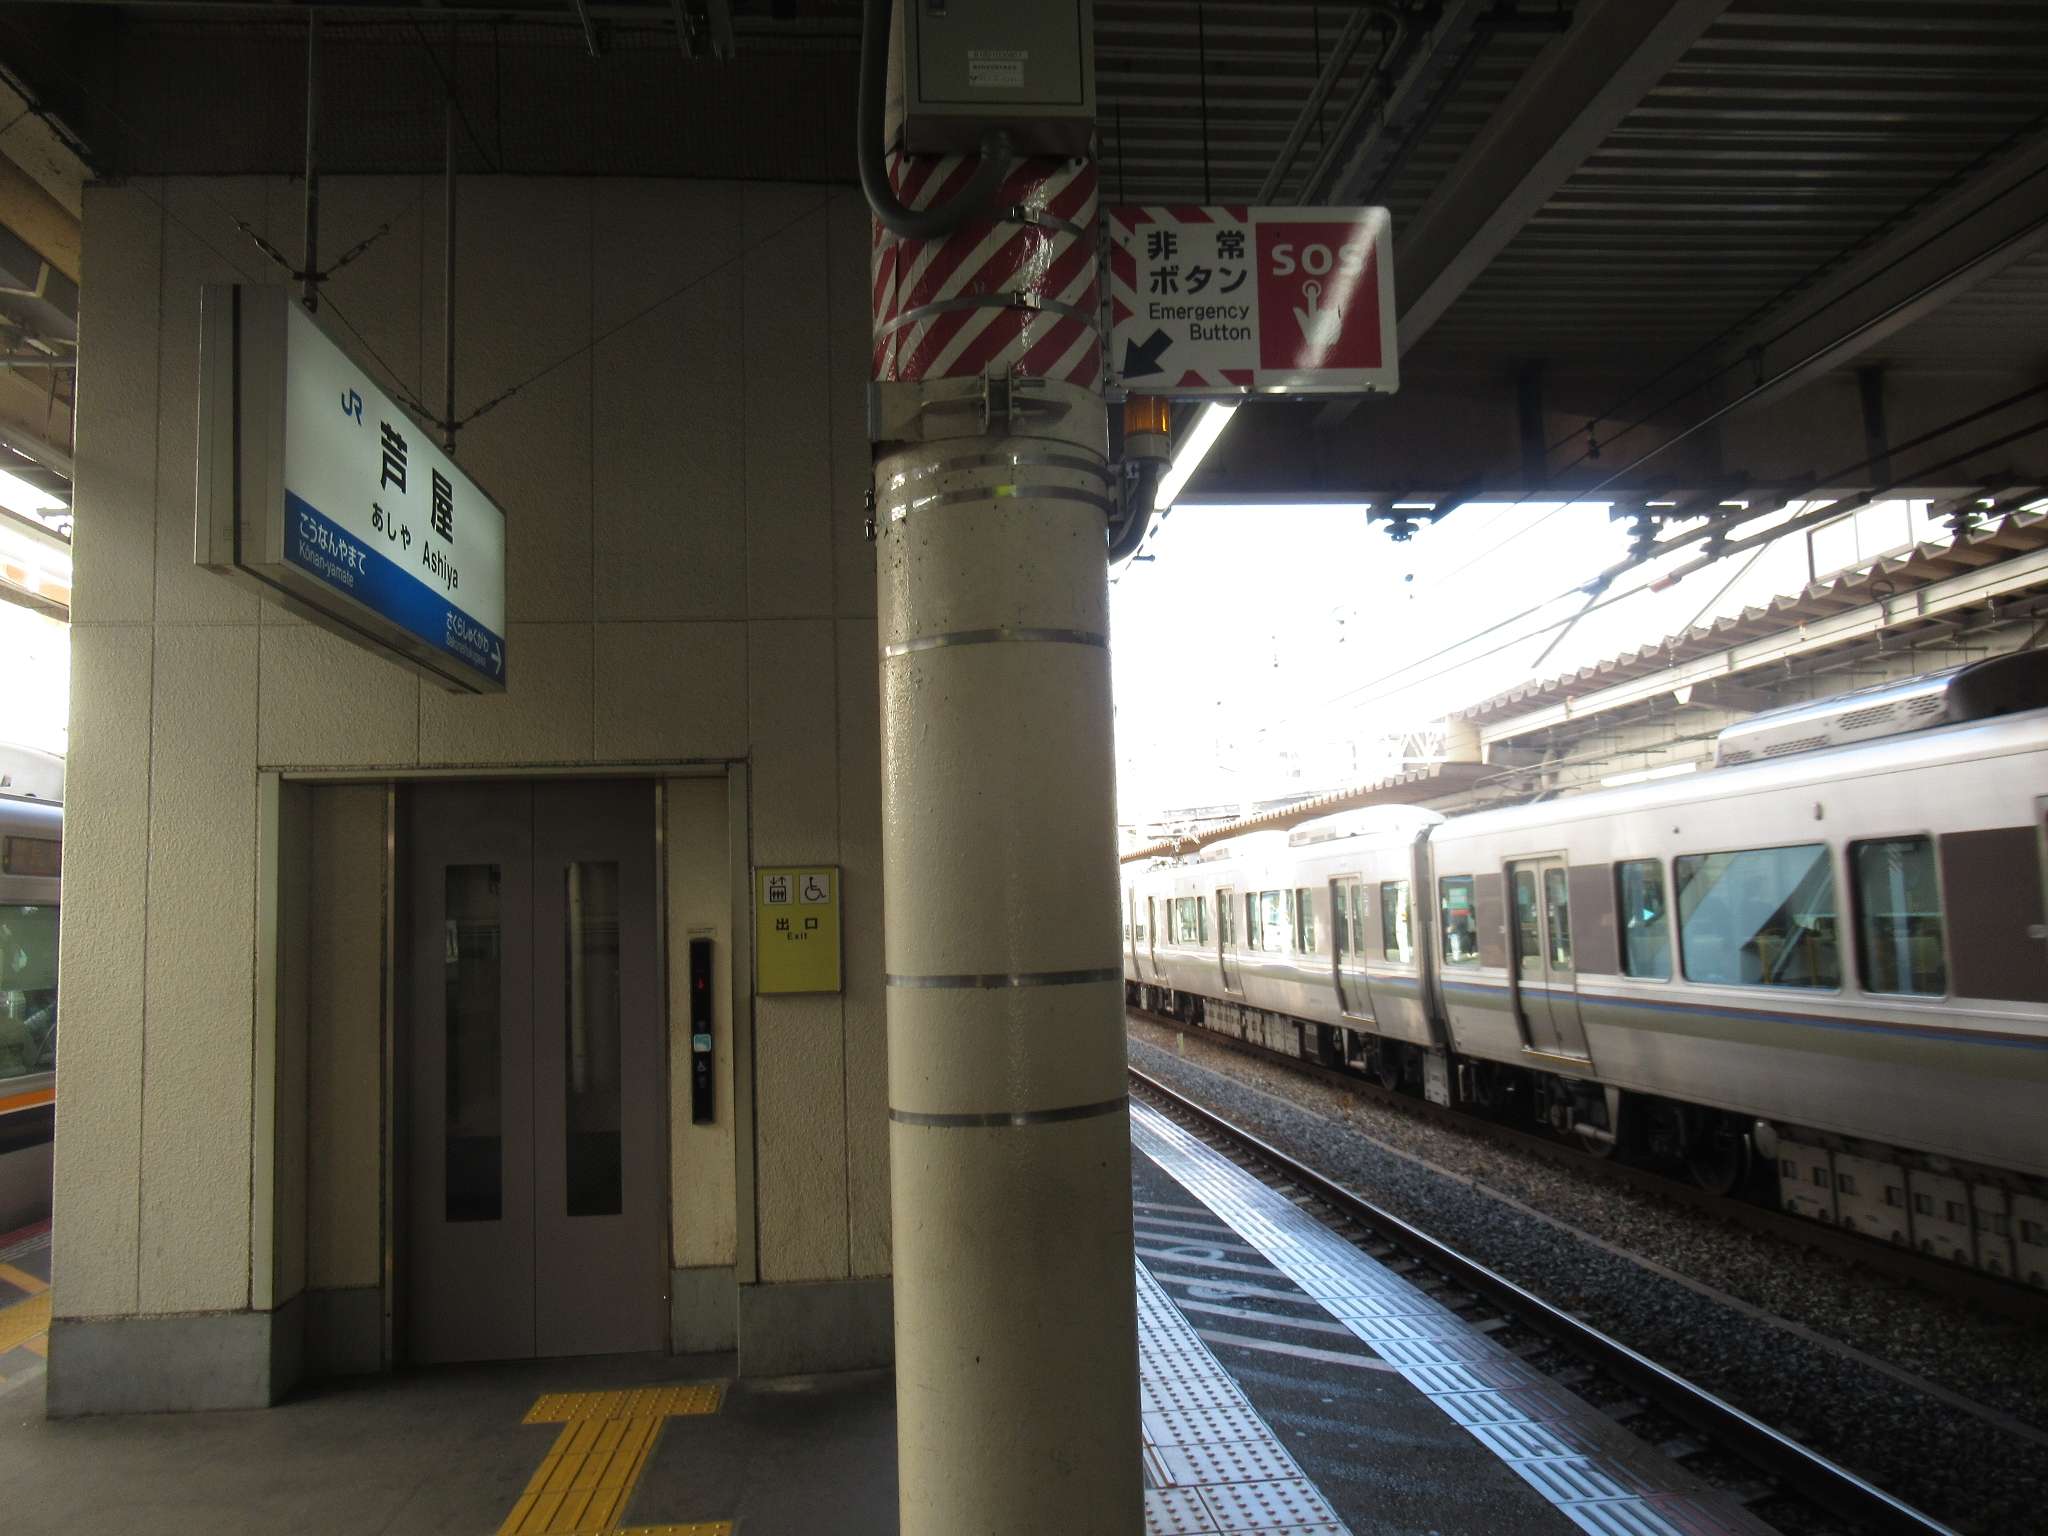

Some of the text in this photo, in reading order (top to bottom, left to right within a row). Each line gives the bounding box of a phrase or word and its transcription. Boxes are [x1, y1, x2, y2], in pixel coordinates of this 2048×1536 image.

[1147, 230, 1246, 260] 非常
[1271, 244, 1364, 276] SOS
[1150, 265, 1248, 295] ボタン
[1149, 302, 1250, 320] Emergency
[1189, 323, 1251, 341] Button
[341, 388, 363, 426] JR
[380, 420, 454, 545] 芦屋
[371, 502, 412, 551] あしや
[299, 512, 367, 576] こうなんやまて
[422, 541, 459, 590] Ashiya
[775, 917, 818, 931] 出口
[786, 932, 808, 940] Exit
